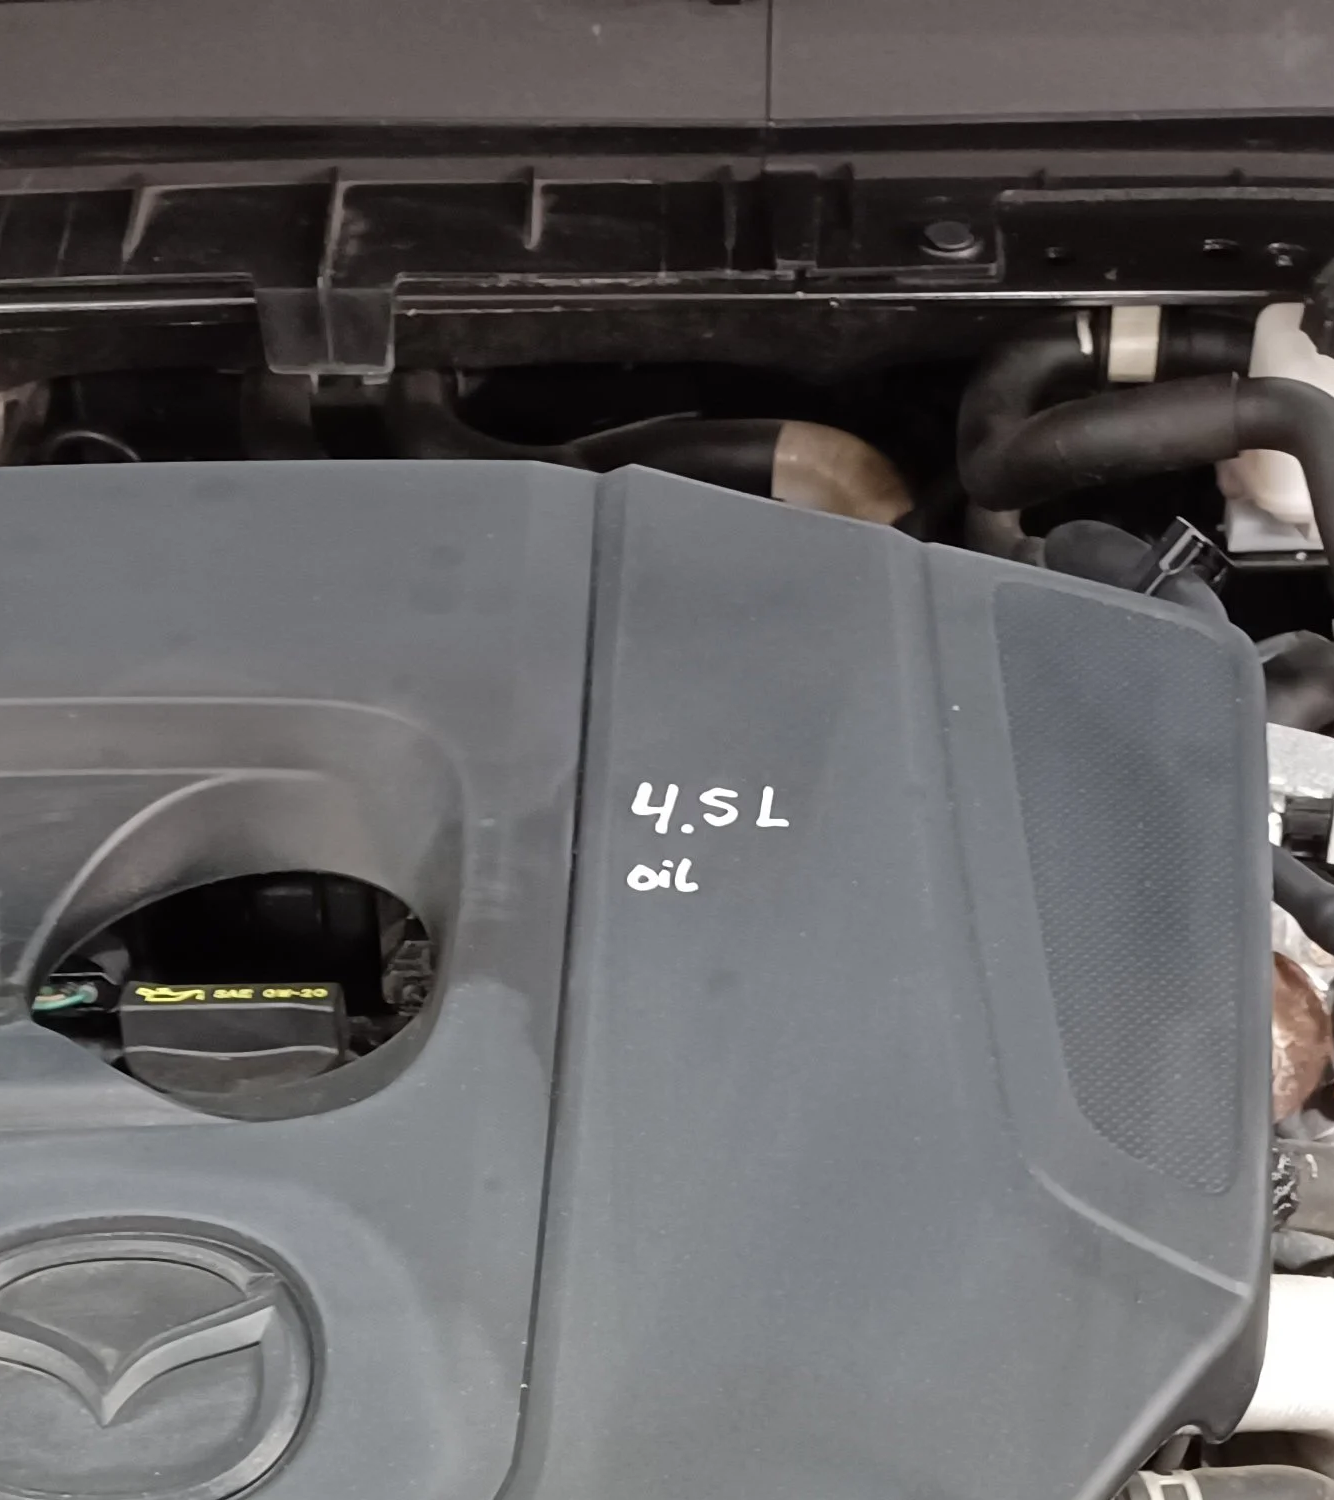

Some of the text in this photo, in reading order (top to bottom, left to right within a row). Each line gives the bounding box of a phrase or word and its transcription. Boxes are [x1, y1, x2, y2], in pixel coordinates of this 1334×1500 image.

[631, 781, 790, 834] 4.5 L
[626, 857, 699, 893] oil
[213, 987, 255, 999] SAE
